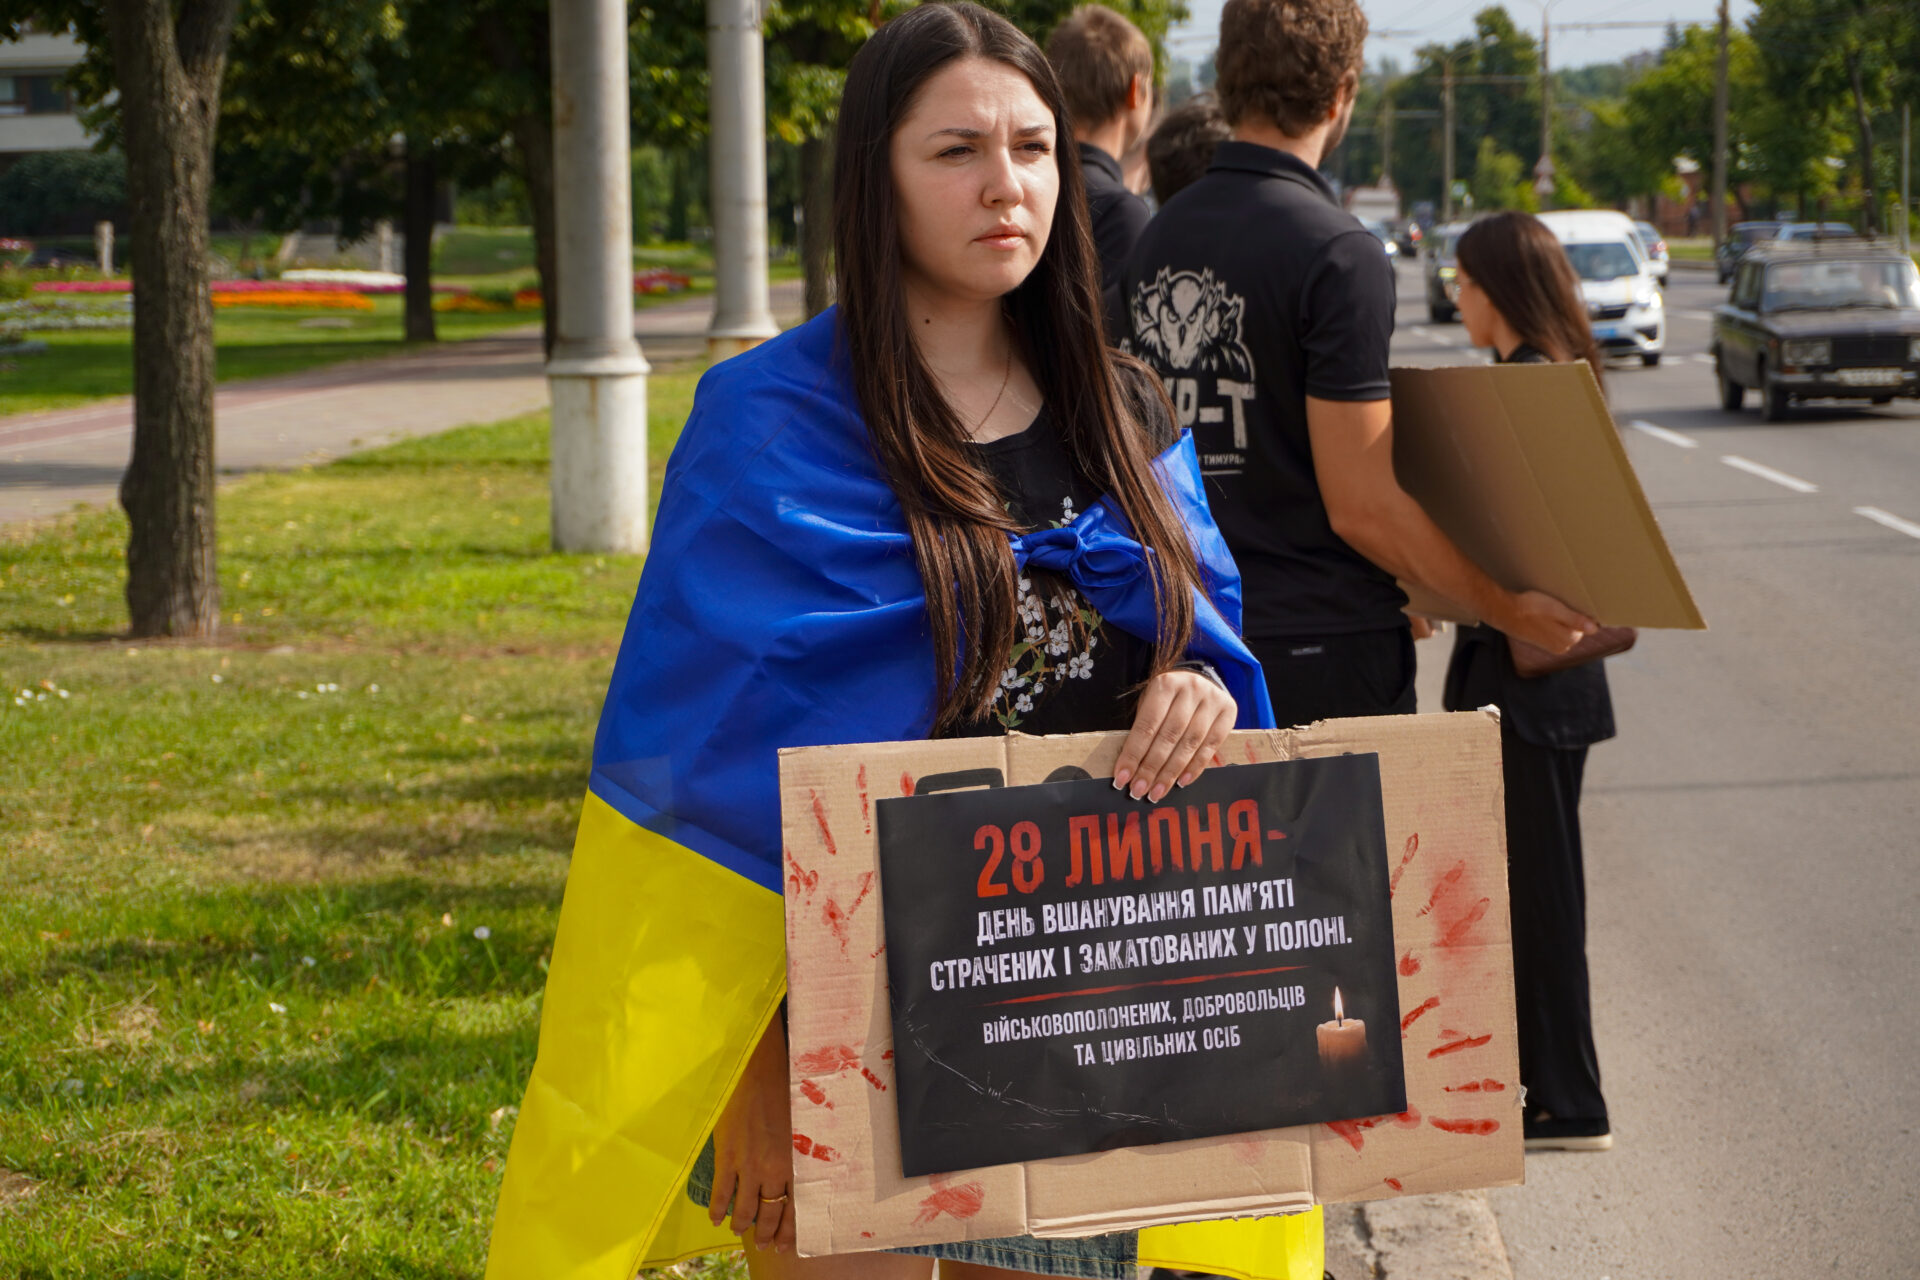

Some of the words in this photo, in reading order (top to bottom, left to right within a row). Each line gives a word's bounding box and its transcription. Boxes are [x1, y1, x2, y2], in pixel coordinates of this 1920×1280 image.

[973, 820, 1045, 898] 28
[1065, 799, 1288, 888] ЛИПНЯ-
[976, 907, 1036, 946] ДЕНЬ
[1043, 888, 1196, 935] ВШАНУВАННЯ
[930, 948, 1057, 991] СТРАЧЕНИХ
[1080, 930, 1237, 974] ЗАКАТОВАНИХ
[1245, 929, 1258, 955] У
[1265, 915, 1353, 952] ПОЛОНІ.
[983, 1003, 1177, 1044] ВІЙСЬКОВОПОЛОНЕНИХ,
[1182, 985, 1306, 1023] ДОБРОВОЛЬЦІВ
[1074, 1042, 1096, 1066] ТА
[1101, 1034, 1198, 1065] ЦИВІЛЬНИХ
[1203, 1025, 1241, 1050] ОСІБ
